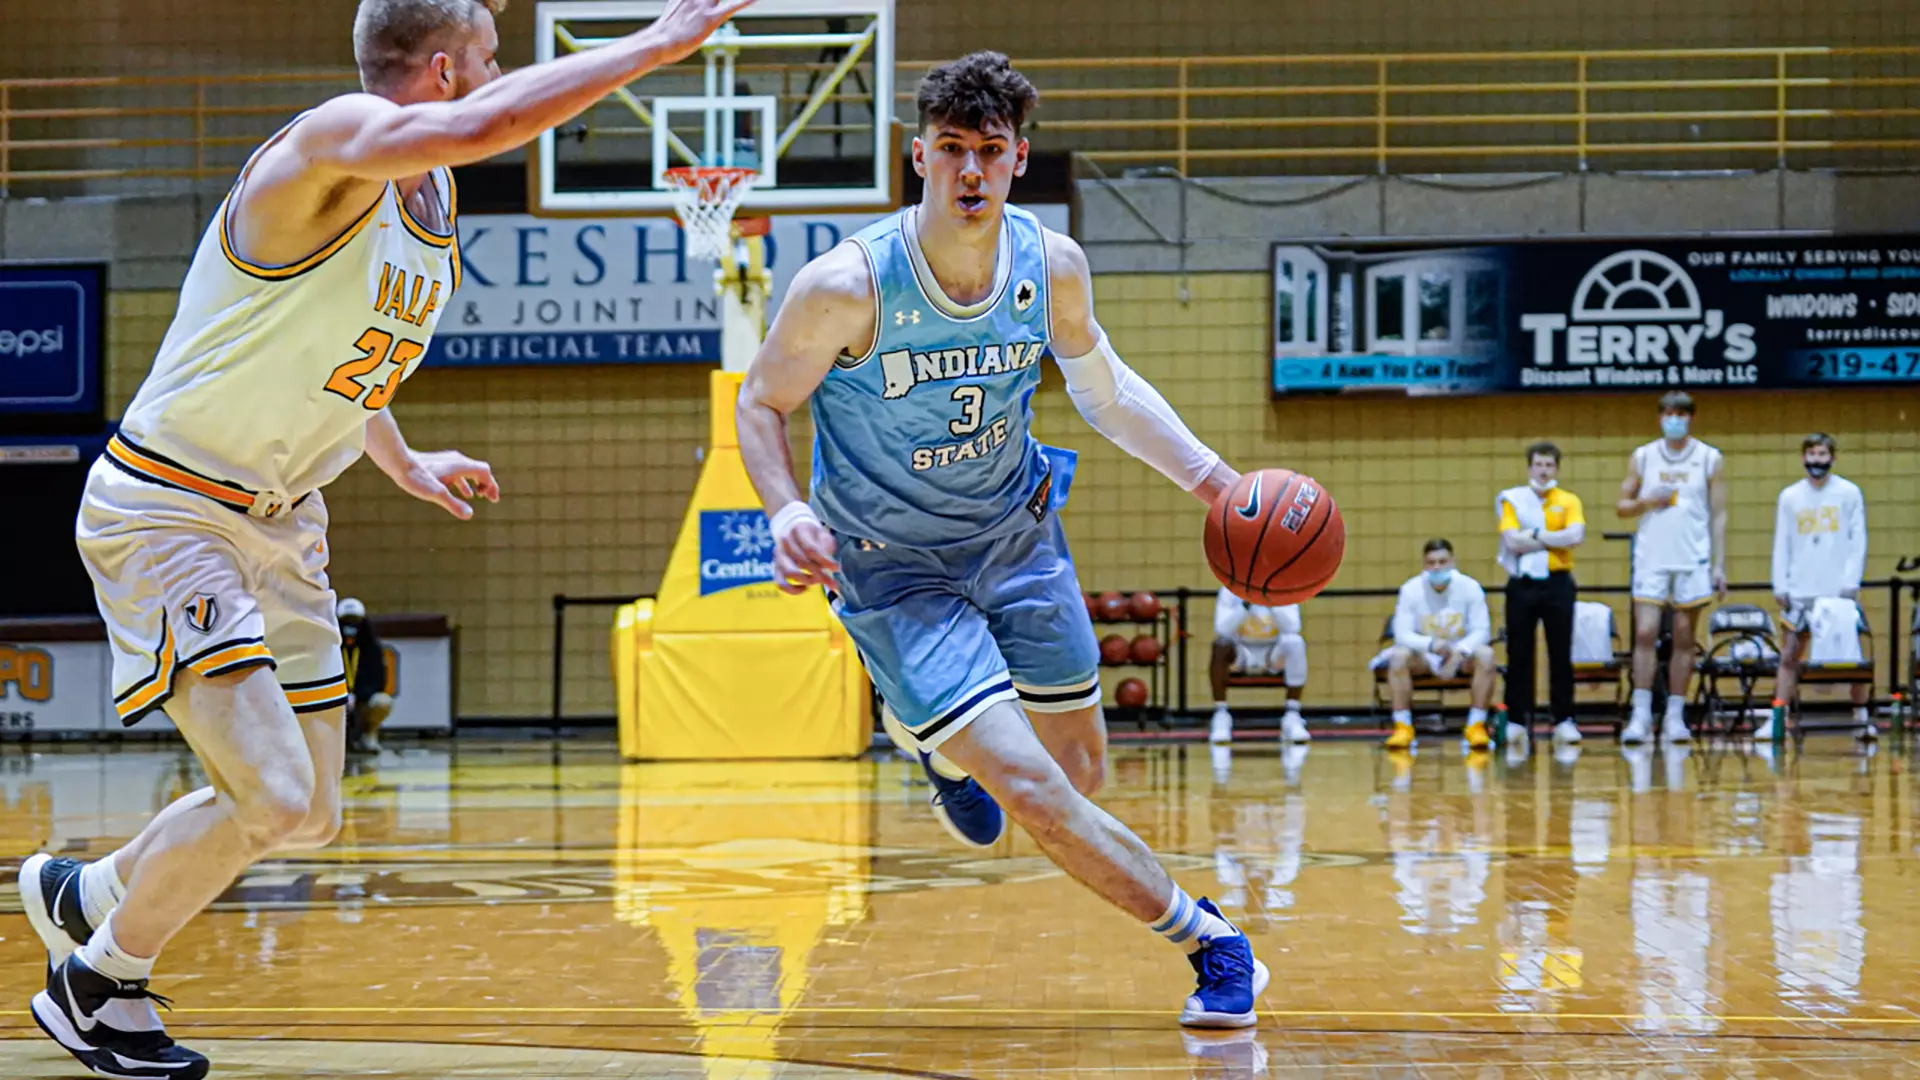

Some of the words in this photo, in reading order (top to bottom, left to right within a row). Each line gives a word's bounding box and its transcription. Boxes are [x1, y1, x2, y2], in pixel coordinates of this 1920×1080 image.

[1687, 251, 1725, 265] OUR
[1731, 250, 1797, 265] FAMILY
[1803, 249, 1881, 264] SERVING
[462, 301, 481, 326] &
[512, 298, 644, 325] JOINT
[1766, 292, 1858, 319] WINDOWS
[444, 336, 600, 360] OFFICIAL
[613, 334, 703, 358] TEAM
[1520, 308, 1758, 366] TERRY'S
[323, 326, 424, 411] 23
[1520, 367, 1591, 386] Discount
[1595, 366, 1664, 385] Windows
[1667, 366, 1680, 384] &
[1683, 366, 1723, 384] More
[1726, 365, 1758, 383] LLC
[1807, 351, 1920, 378] 219-47
[949, 384, 987, 437] 3
[911, 416, 1009, 472] STATE
